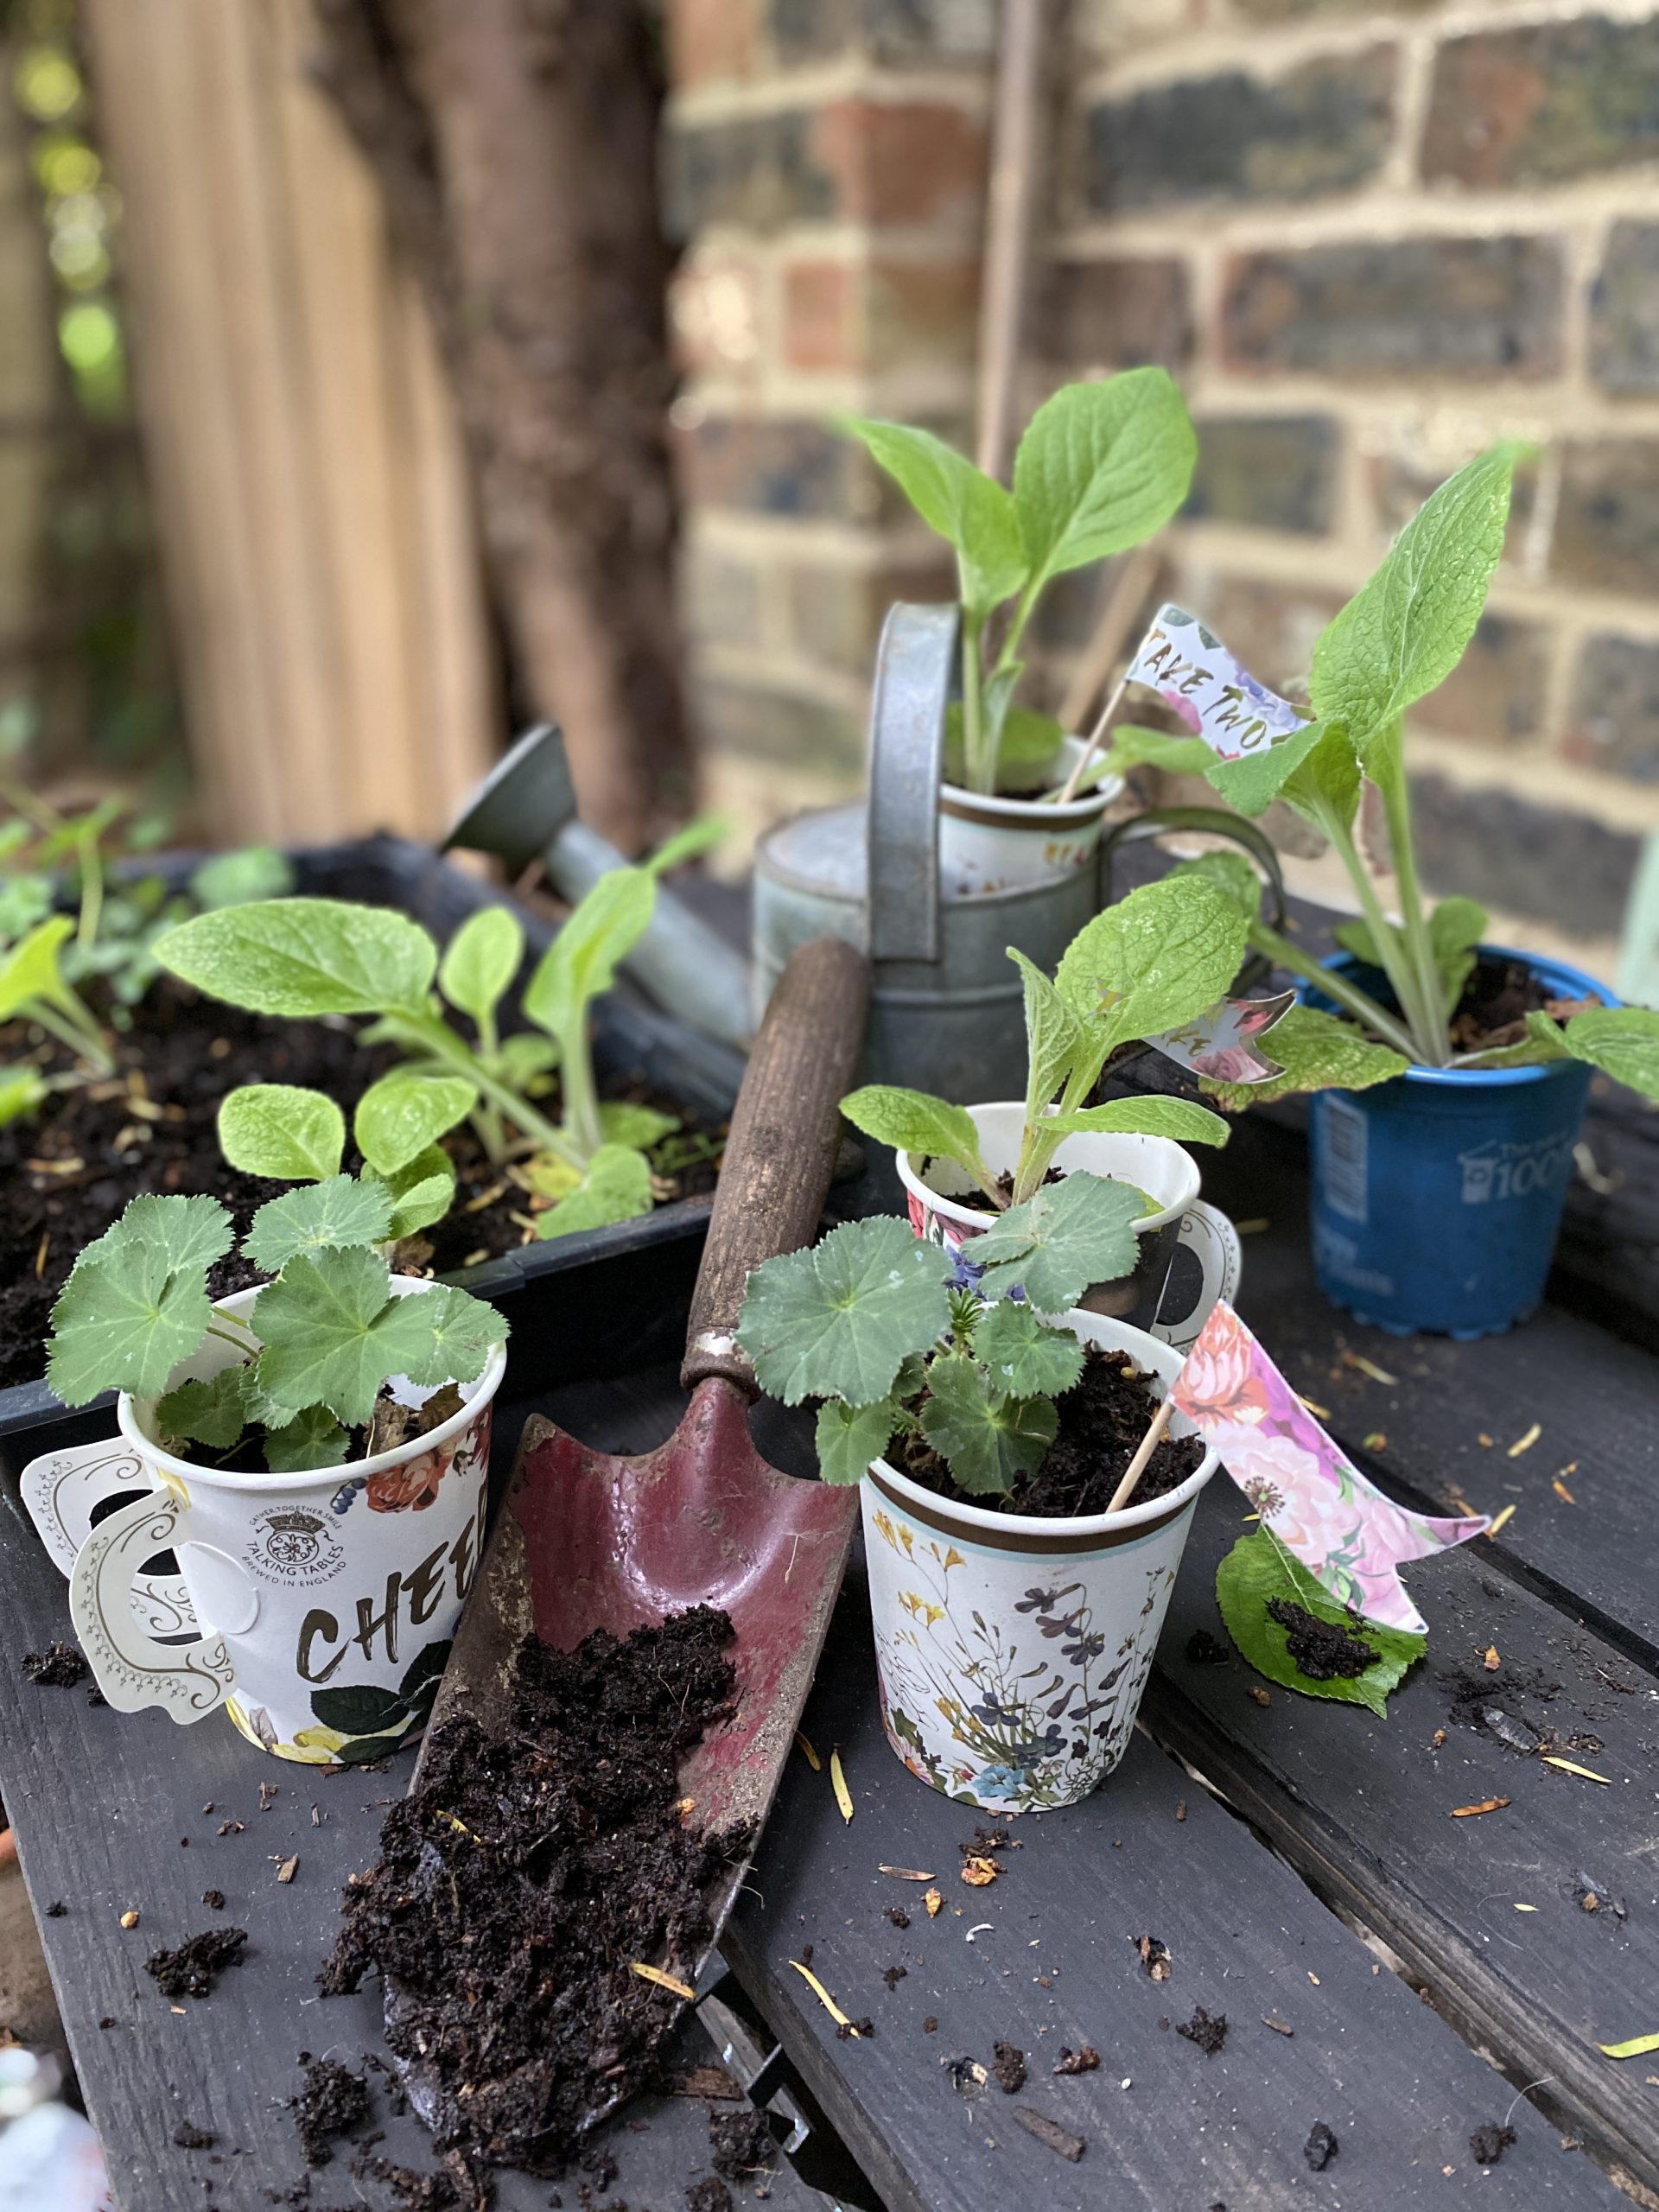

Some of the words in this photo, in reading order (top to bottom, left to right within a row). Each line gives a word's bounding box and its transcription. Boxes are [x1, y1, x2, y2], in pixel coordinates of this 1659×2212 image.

[1202, 685, 1267, 749] TWO
[241, 1556, 279, 1584] BREWED
[299, 1561, 346, 1587] ENGLAND
[246, 1541, 296, 1576] TALKING
[300, 1545, 344, 1575] TABLES
[296, 1483, 487, 1684] CHEE
